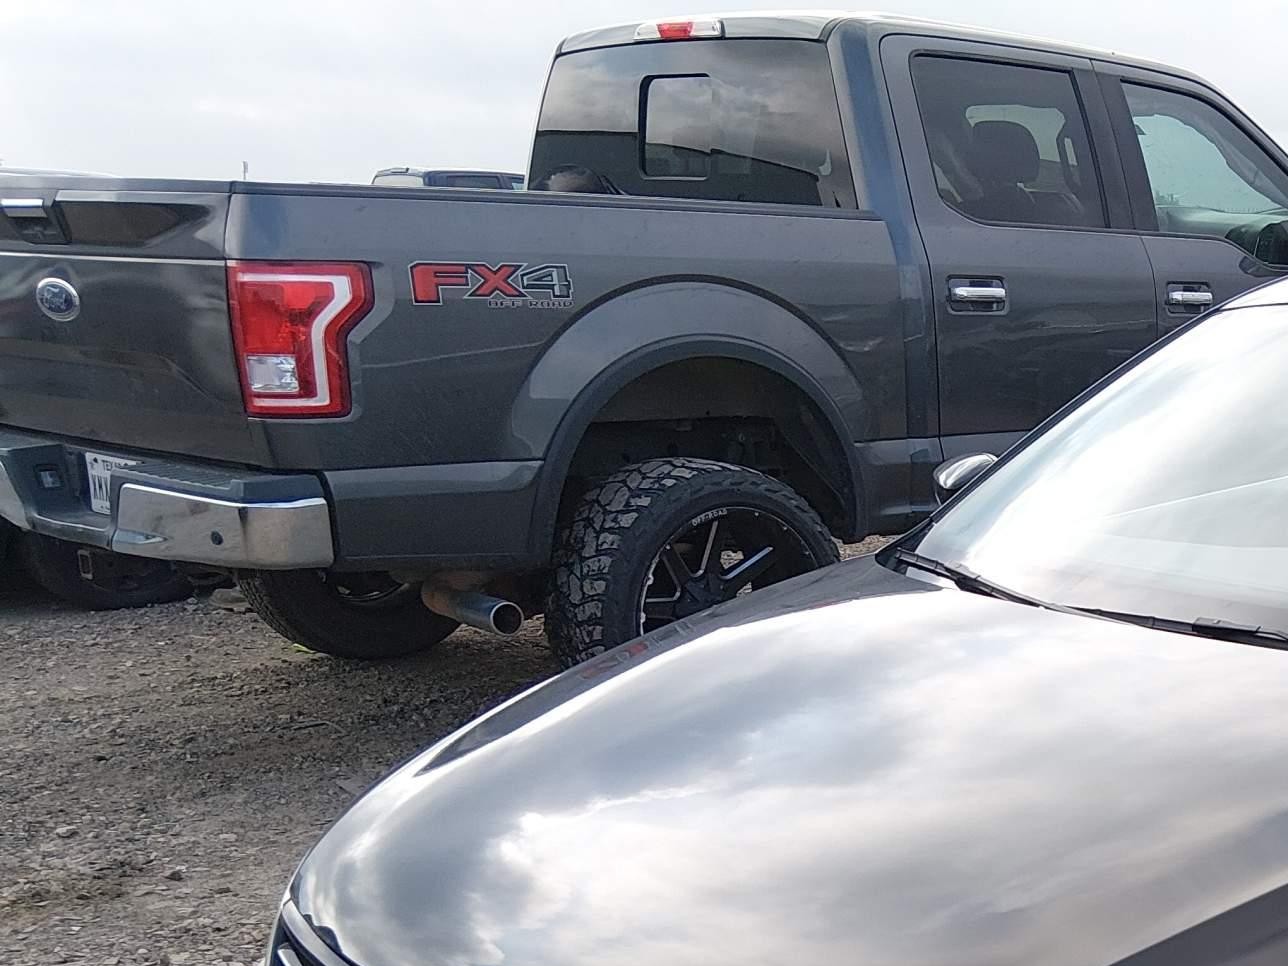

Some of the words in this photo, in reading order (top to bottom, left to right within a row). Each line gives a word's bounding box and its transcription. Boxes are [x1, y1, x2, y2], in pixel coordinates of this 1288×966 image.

[407, 260, 574, 306] FX4
[488, 300, 523, 309] OFF
[528, 300, 574, 309] ROAD
